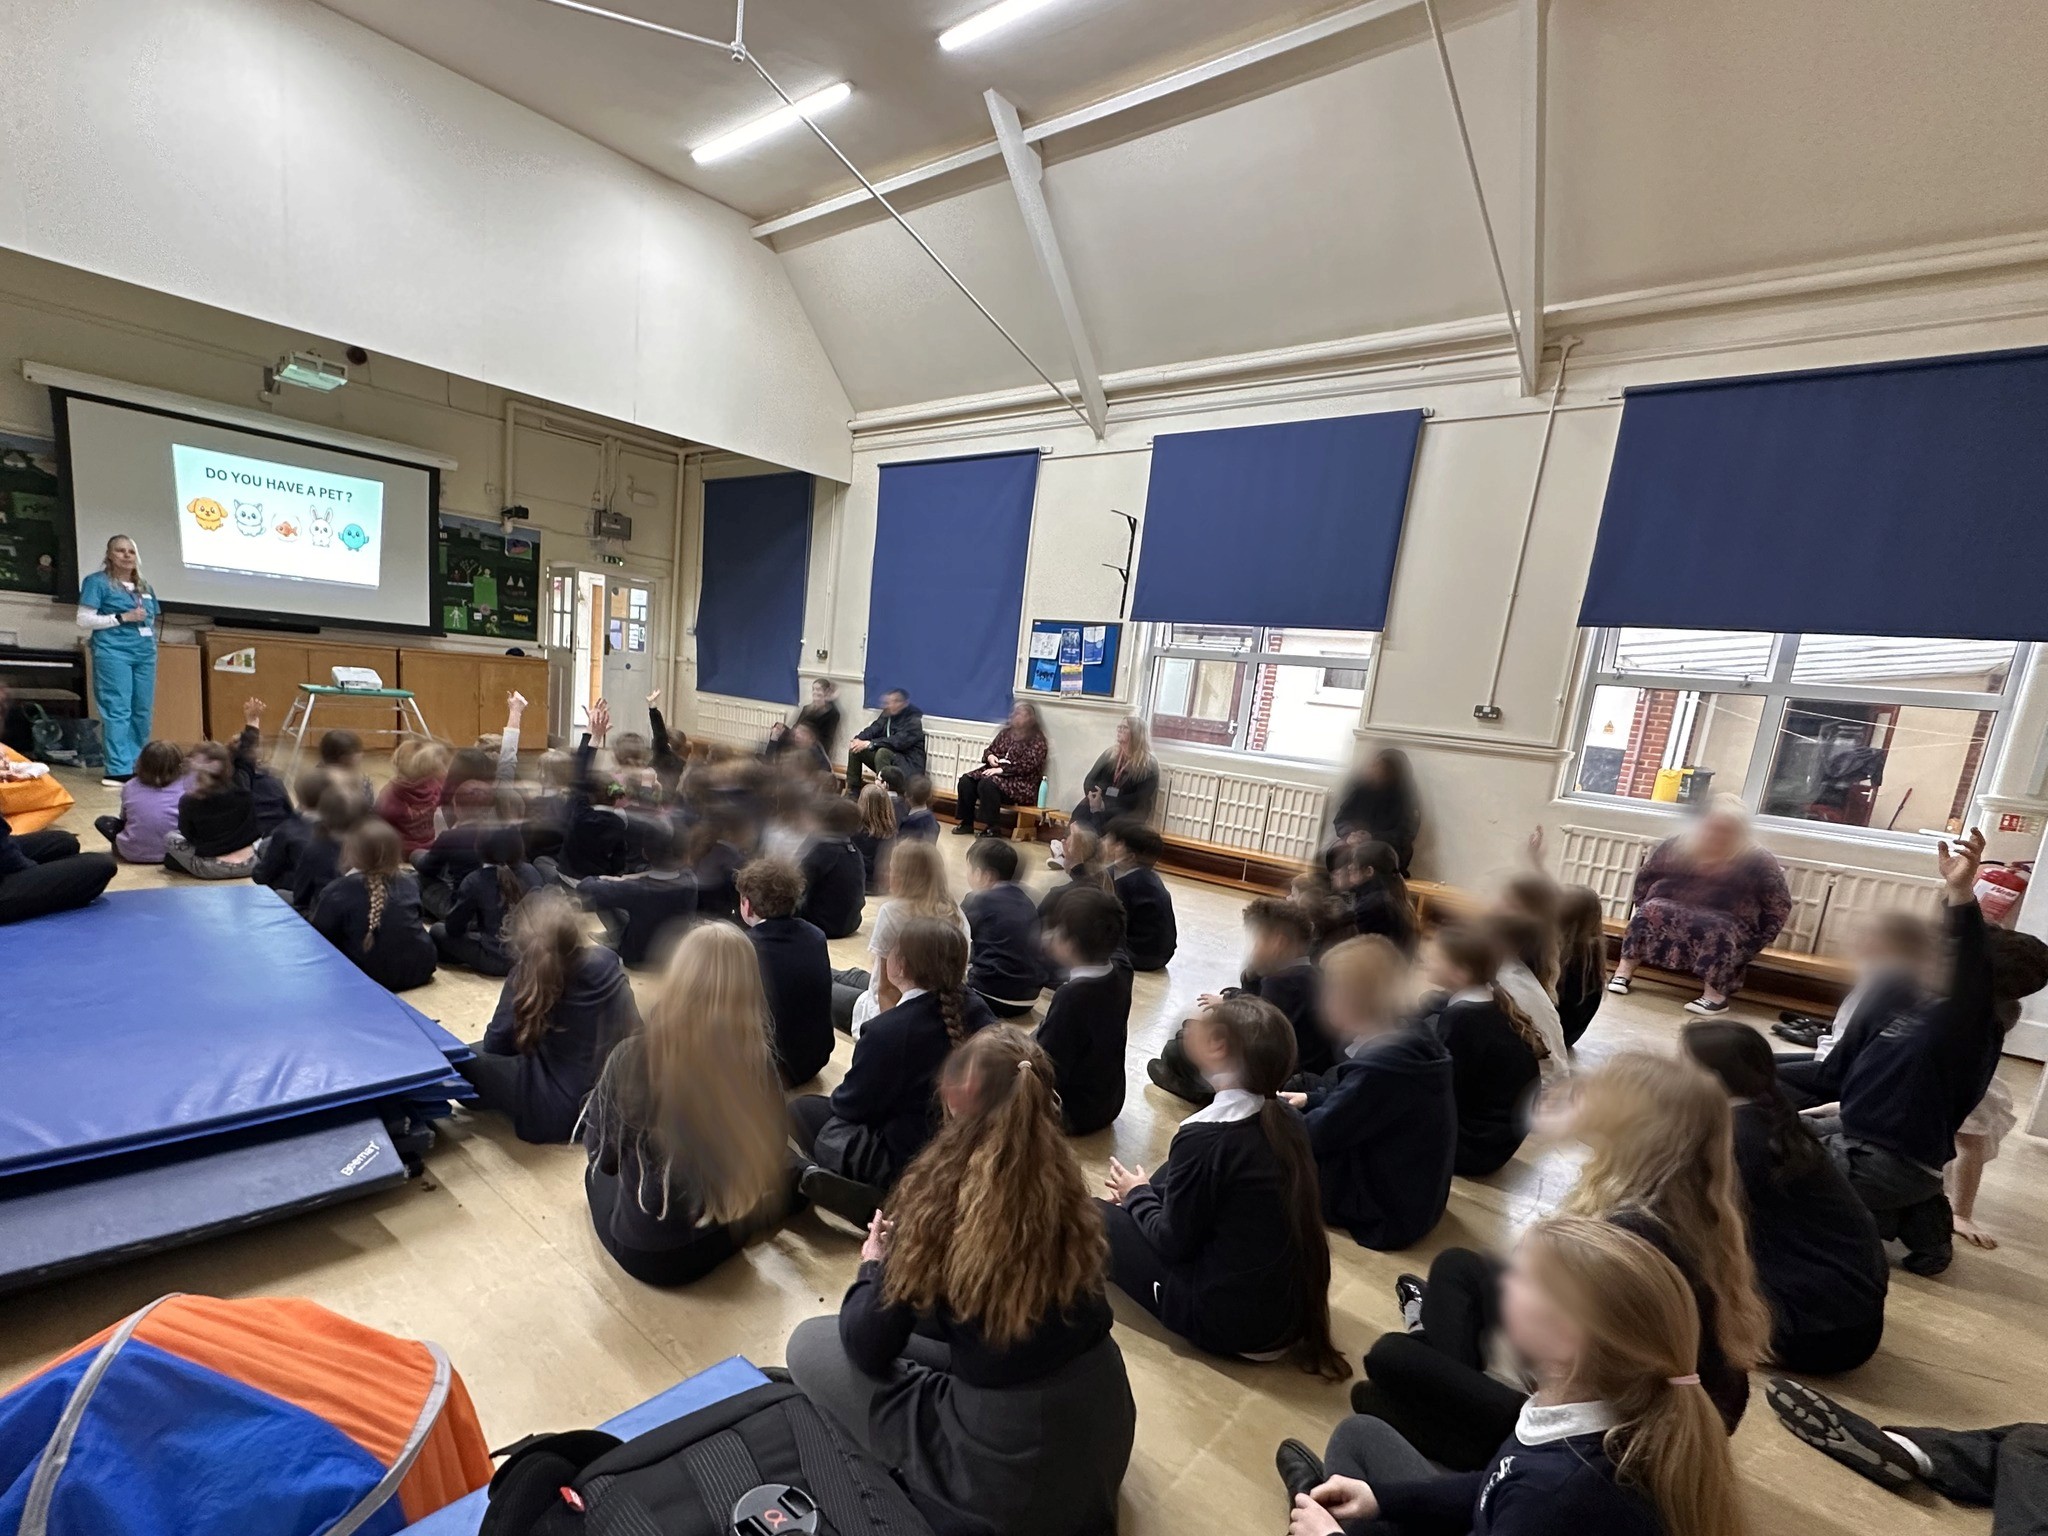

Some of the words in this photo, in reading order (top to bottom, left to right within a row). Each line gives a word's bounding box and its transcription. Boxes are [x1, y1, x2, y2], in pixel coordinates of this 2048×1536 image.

[205, 467, 228, 481] DO
[231, 471, 262, 487] YOU
[266, 478, 304, 495] HAVE
[306, 485, 316, 497] A
[319, 487, 344, 501] PET
